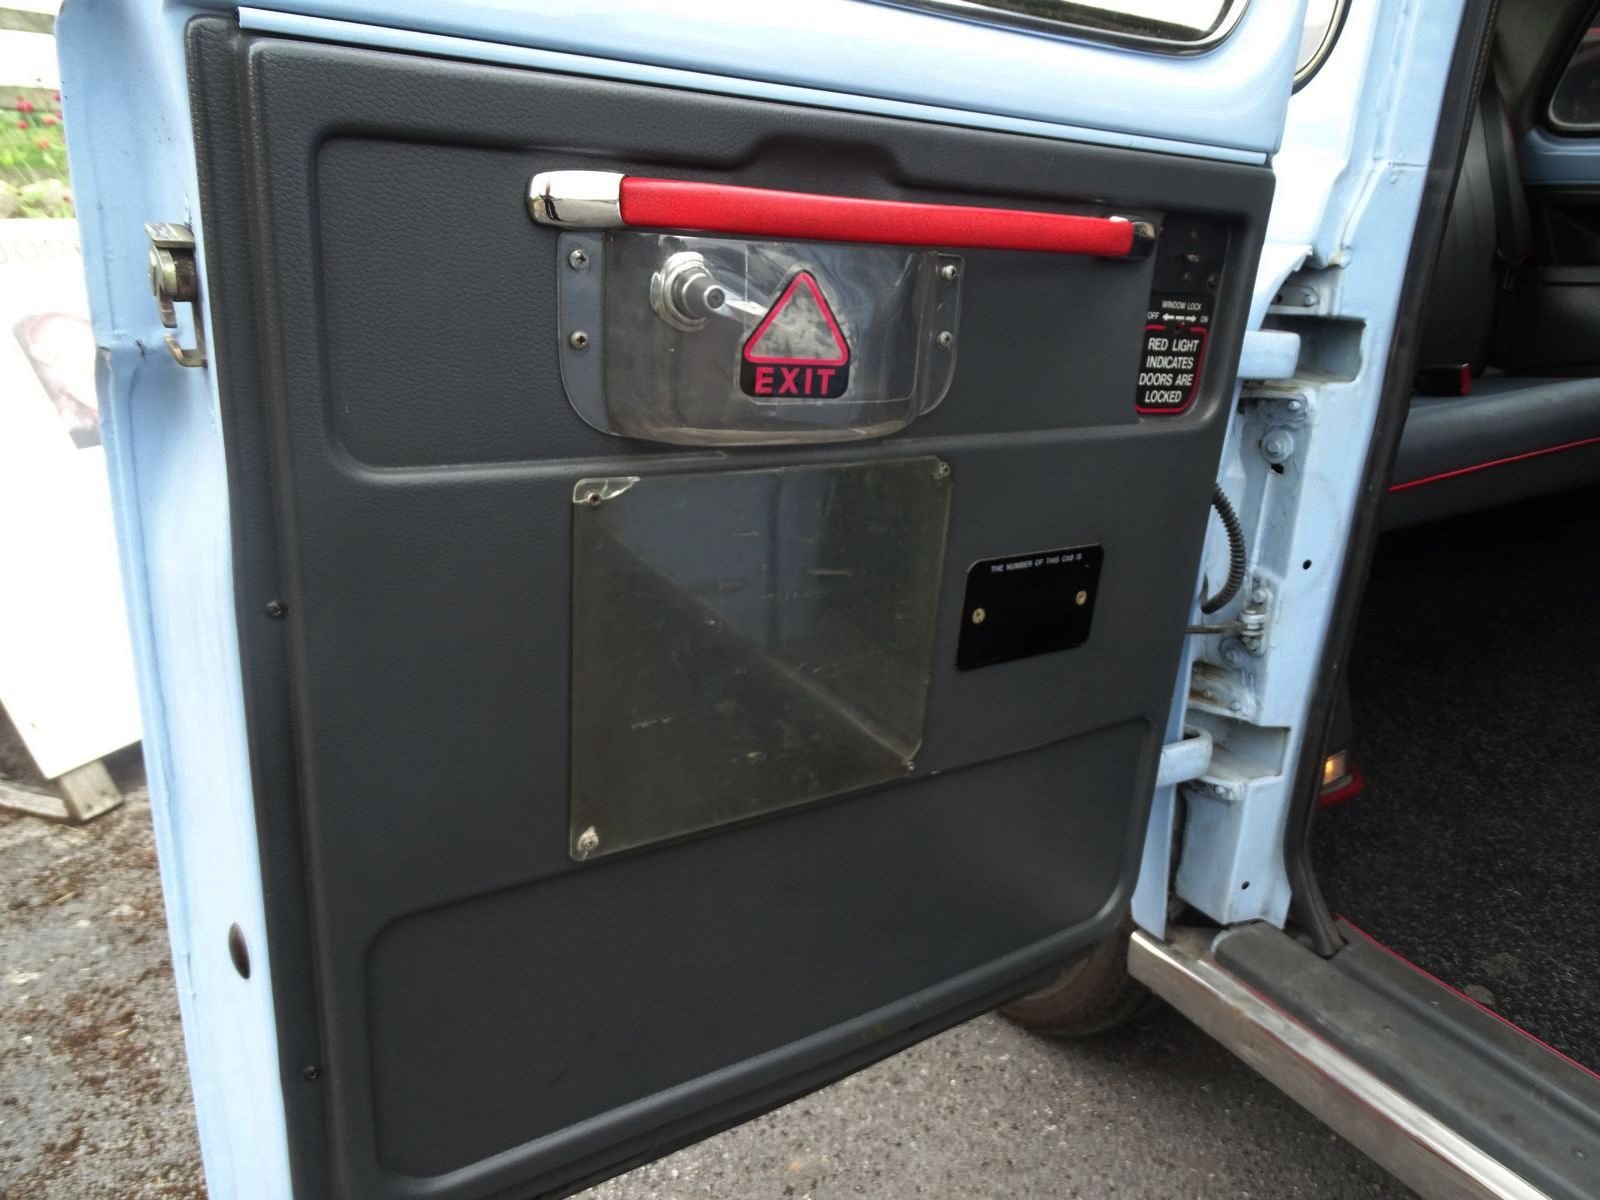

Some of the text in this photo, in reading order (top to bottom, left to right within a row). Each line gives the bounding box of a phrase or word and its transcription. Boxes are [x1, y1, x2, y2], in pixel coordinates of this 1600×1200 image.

[1162, 300, 1202, 311] WINDOW LOCK
[1147, 311, 1160, 320] OFF
[1200, 315, 1209, 323] ON
[1148, 337, 1200, 352] RED LIGHT
[1146, 355, 1194, 369] INDICATES
[754, 366, 837, 396] EXIT
[1139, 373, 1194, 386] DOORS ARE
[1144, 389, 1182, 403] LOCKED
[991, 564, 1004, 573] THE
[1005, 560, 1033, 571] NUMBER
[1034, 558, 1044, 567] OF
[1046, 556, 1060, 565] THIS
